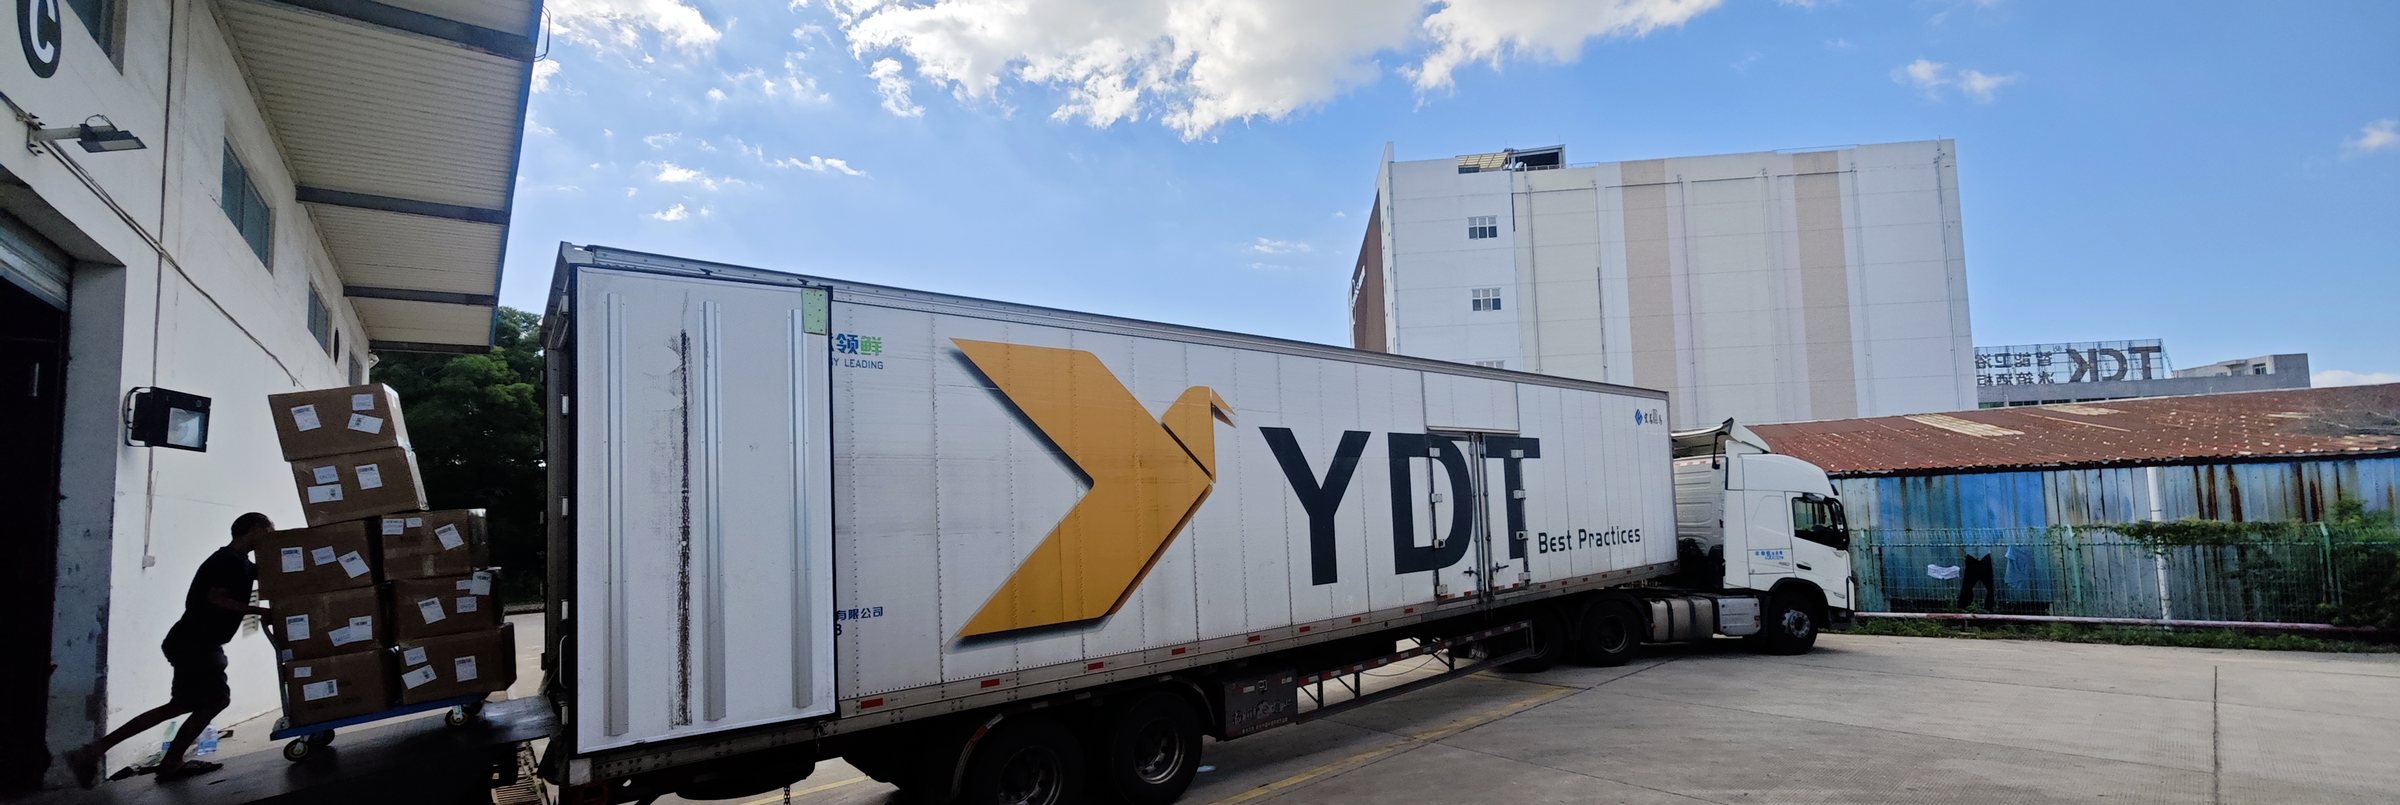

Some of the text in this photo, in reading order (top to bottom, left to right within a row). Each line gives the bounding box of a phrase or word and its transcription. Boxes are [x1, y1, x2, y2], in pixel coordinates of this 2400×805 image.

[30, 0, 56, 63] C
[832, 333, 882, 356] 领鲜
[831, 357, 884, 370] Y LEADING
[1258, 426, 1541, 586] YDT
[1538, 525, 1641, 554] Best Practices
[836, 606, 883, 621] 有限公司
